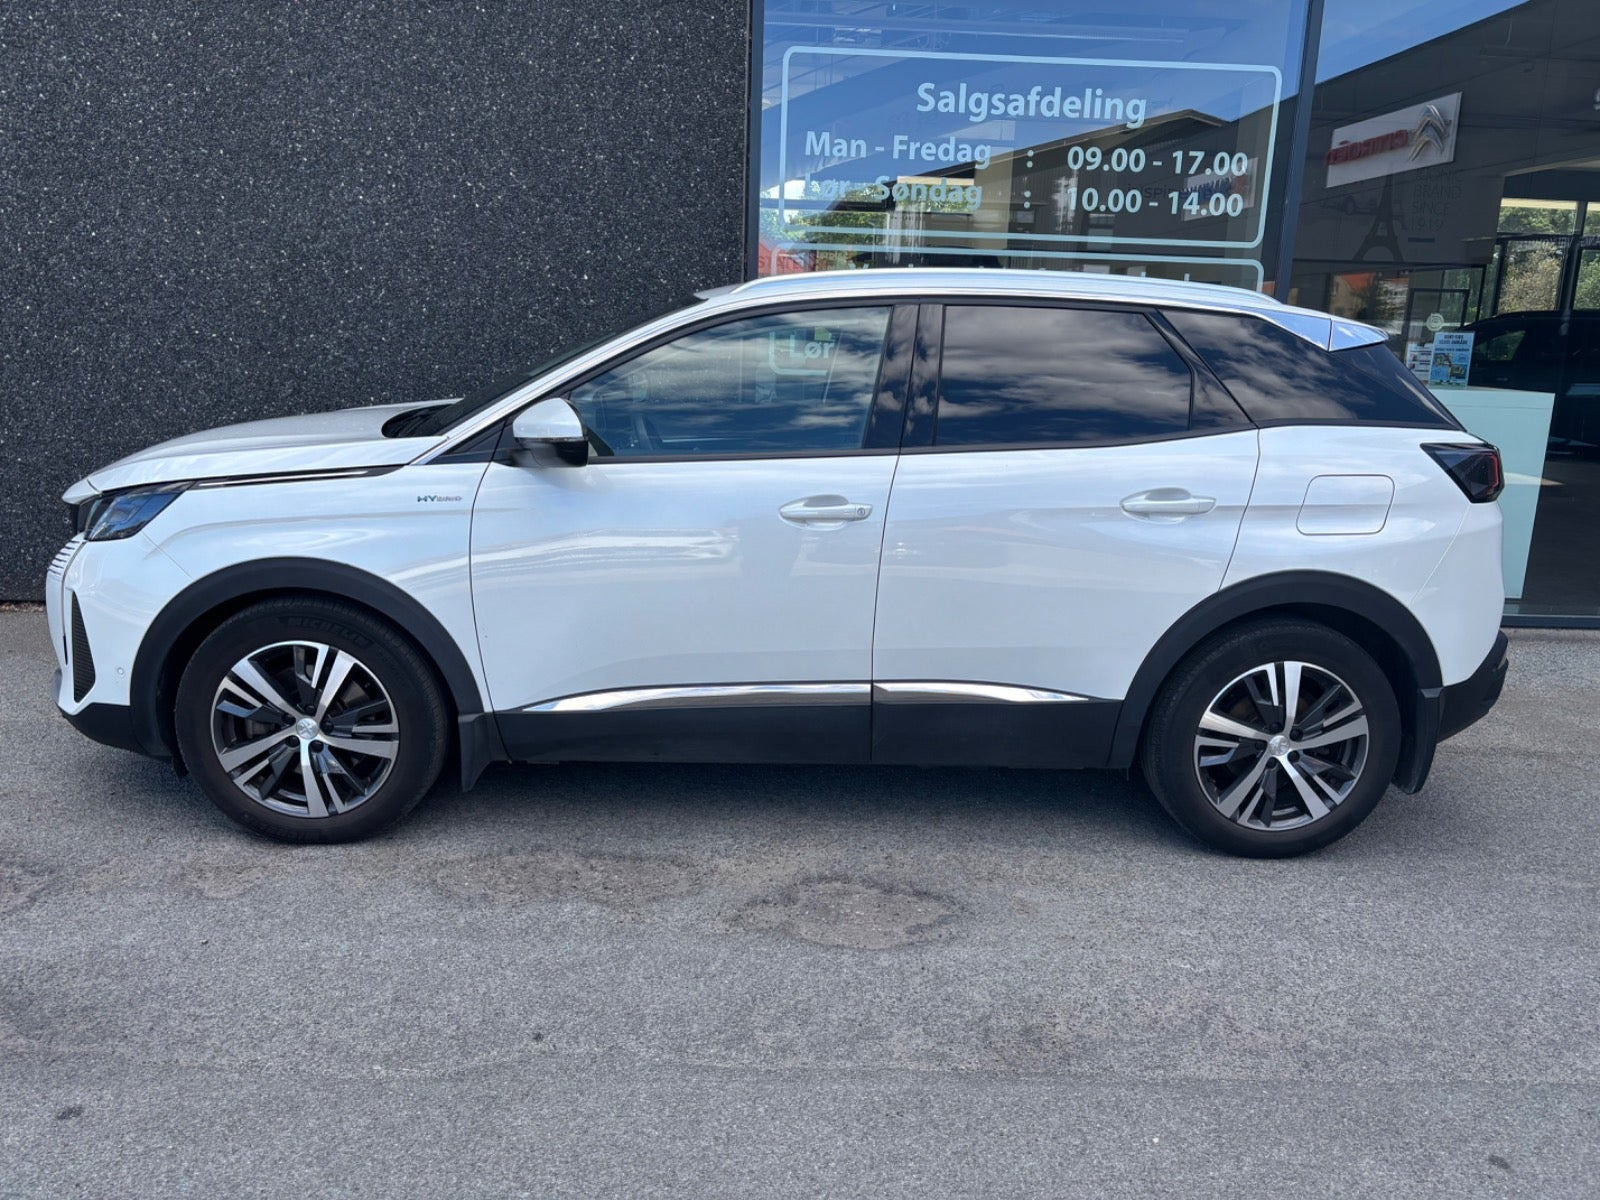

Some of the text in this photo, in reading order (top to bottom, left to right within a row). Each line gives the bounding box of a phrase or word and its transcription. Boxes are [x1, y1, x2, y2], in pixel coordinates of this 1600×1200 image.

[916, 82, 1147, 129] Salgsafdeling
[805, 131, 866, 158] Man
[892, 135, 992, 169] Fredag
[1067, 146, 1146, 173] 09.00
[1172, 150, 1248, 177] 17.00
[804, 173, 850, 198] Lør
[875, 175, 983, 211] Søndag
[1068, 187, 1142, 213] 10.00
[1168, 191, 1244, 217] 14.00
[789, 334, 835, 359] Lør
